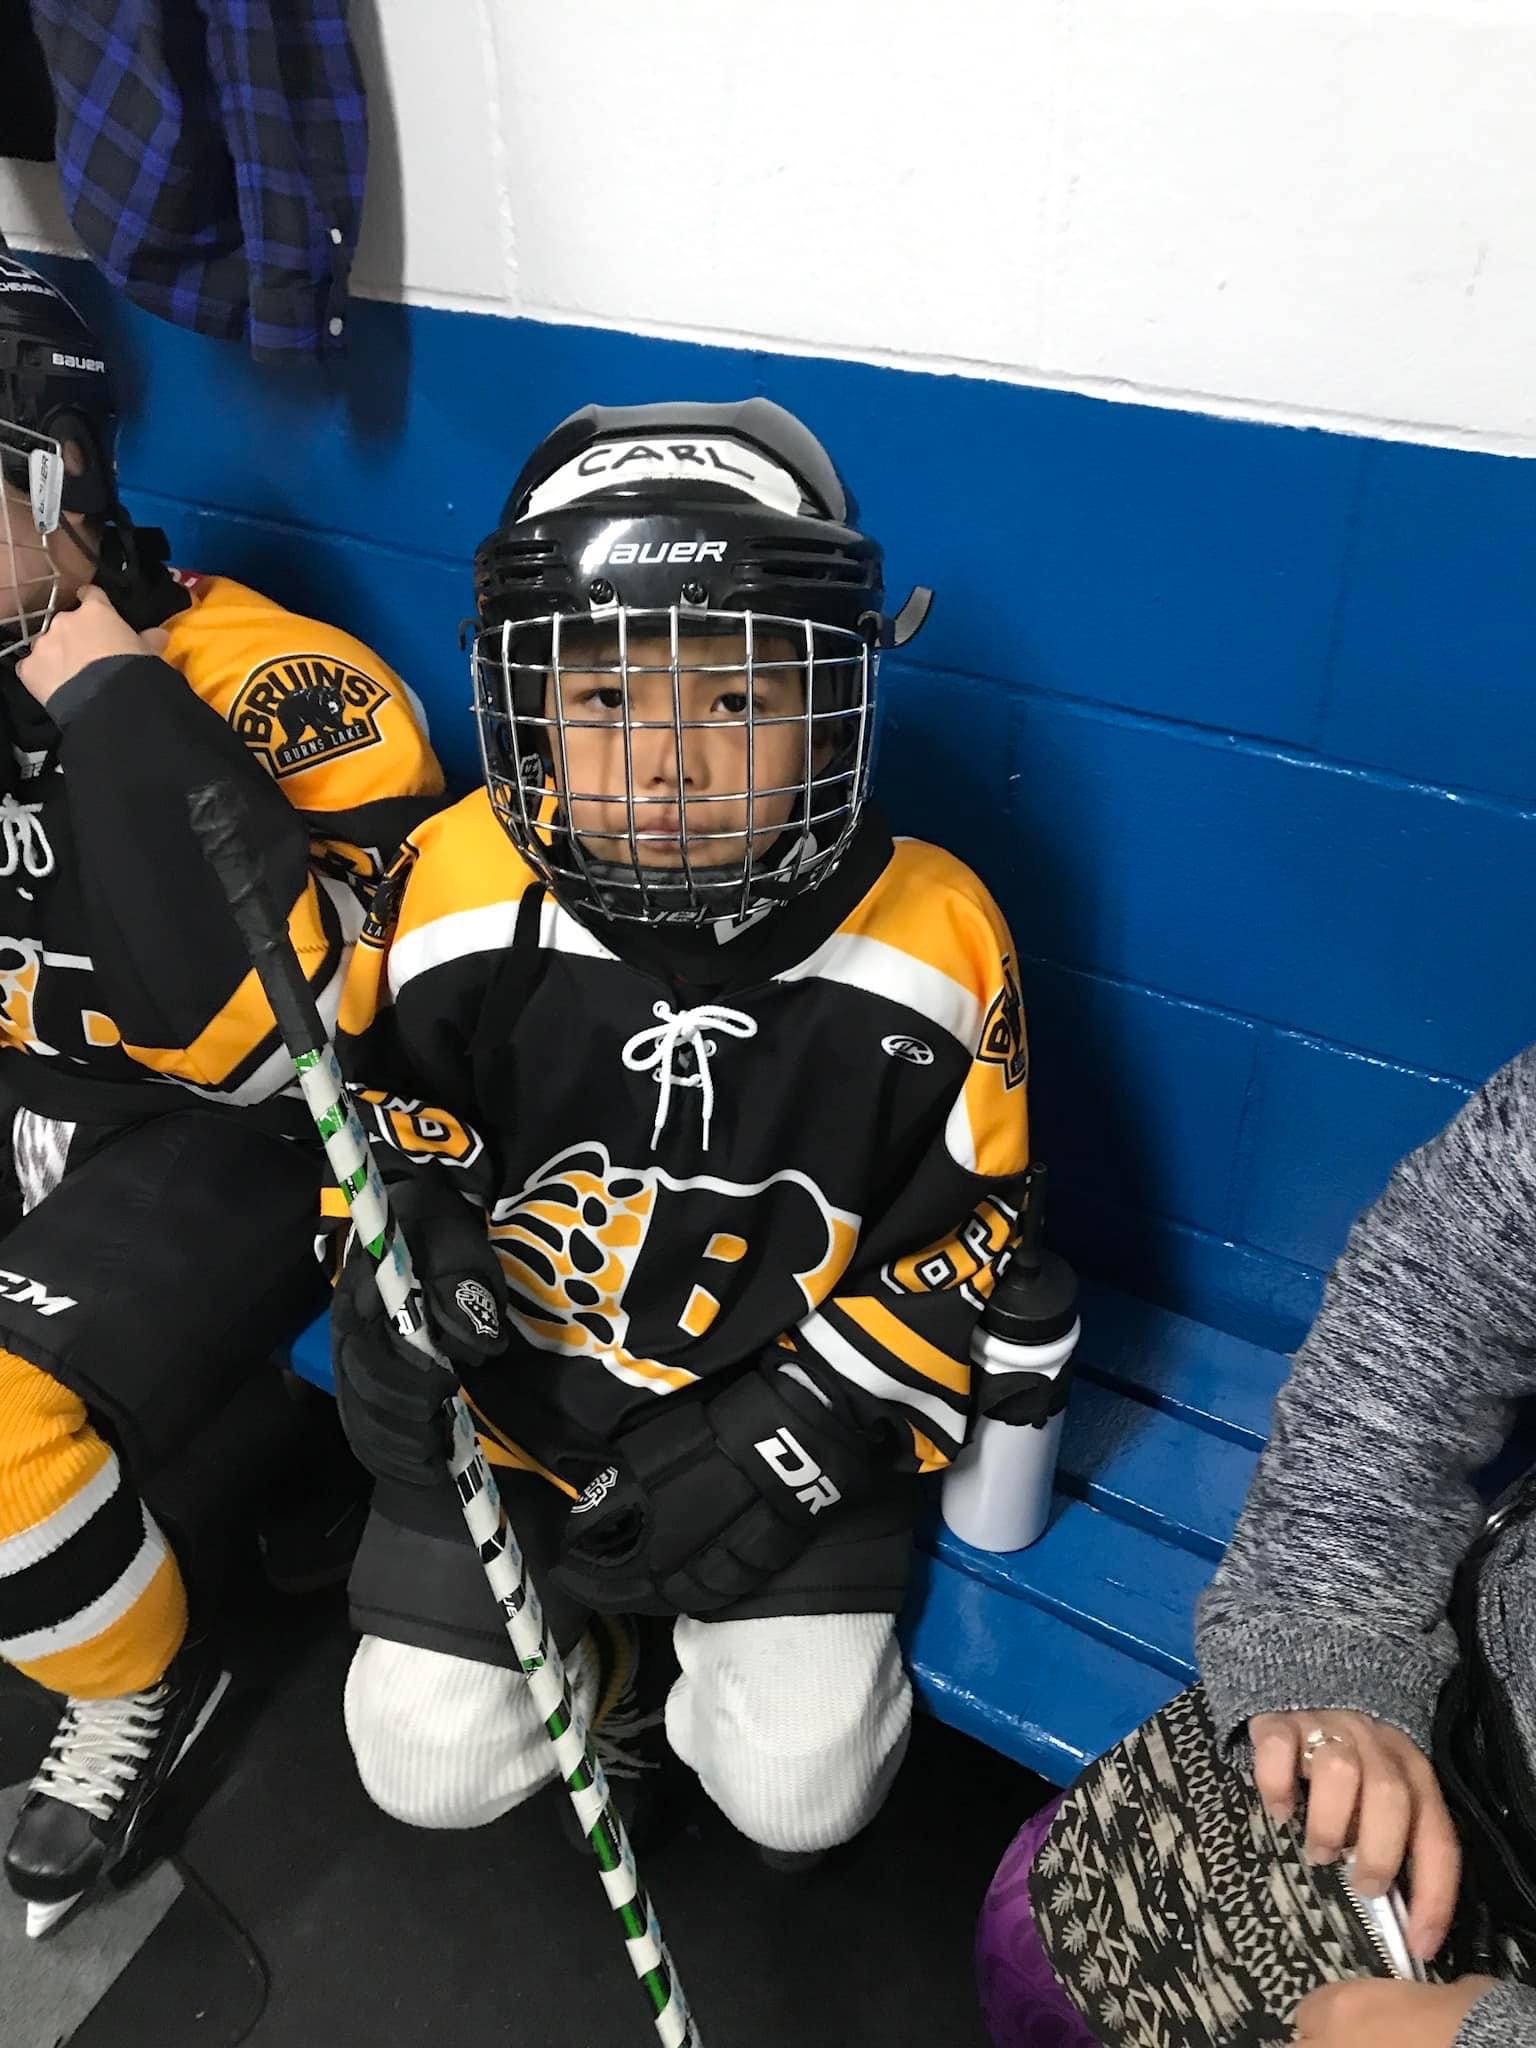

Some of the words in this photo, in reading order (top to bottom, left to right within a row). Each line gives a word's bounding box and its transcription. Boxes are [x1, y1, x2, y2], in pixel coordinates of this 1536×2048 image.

[577, 444, 756, 477] CARL
[237, 660, 378, 743] BRUINS
[282, 736, 326, 763] BURNS
[330, 723, 364, 746] LAKE
[752, 1426, 842, 1516] DR
